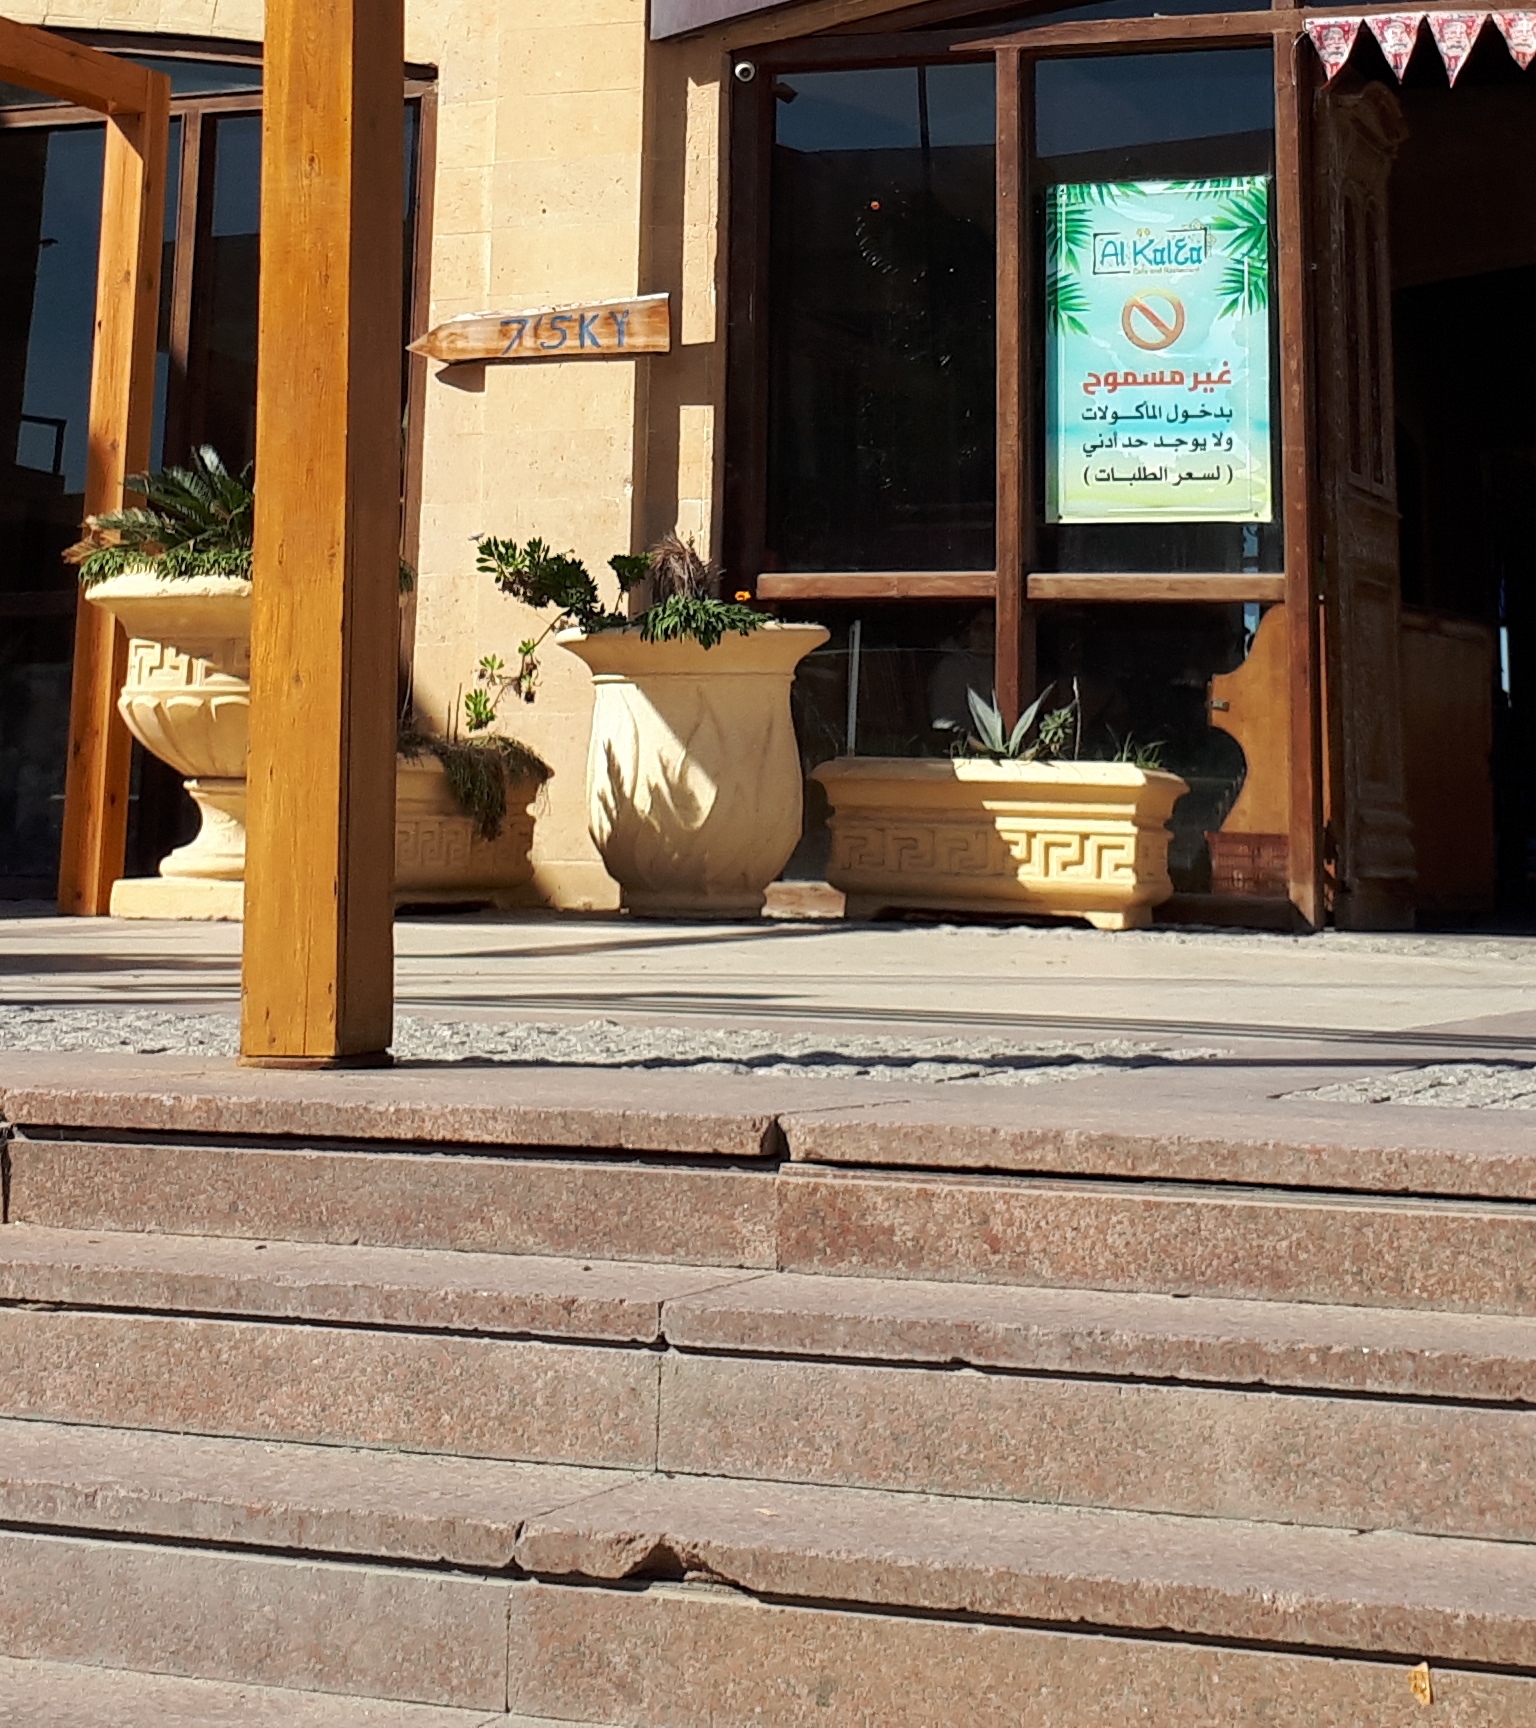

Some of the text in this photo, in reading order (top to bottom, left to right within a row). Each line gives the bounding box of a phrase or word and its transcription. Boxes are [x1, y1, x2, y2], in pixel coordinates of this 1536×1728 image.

[1082, 361, 1232, 396] غير مسموح
[1082, 400, 1233, 425] بدخول المأكولات
[1122, 436, 1148, 448] حد
[1154, 435, 1207, 452] يوجد
